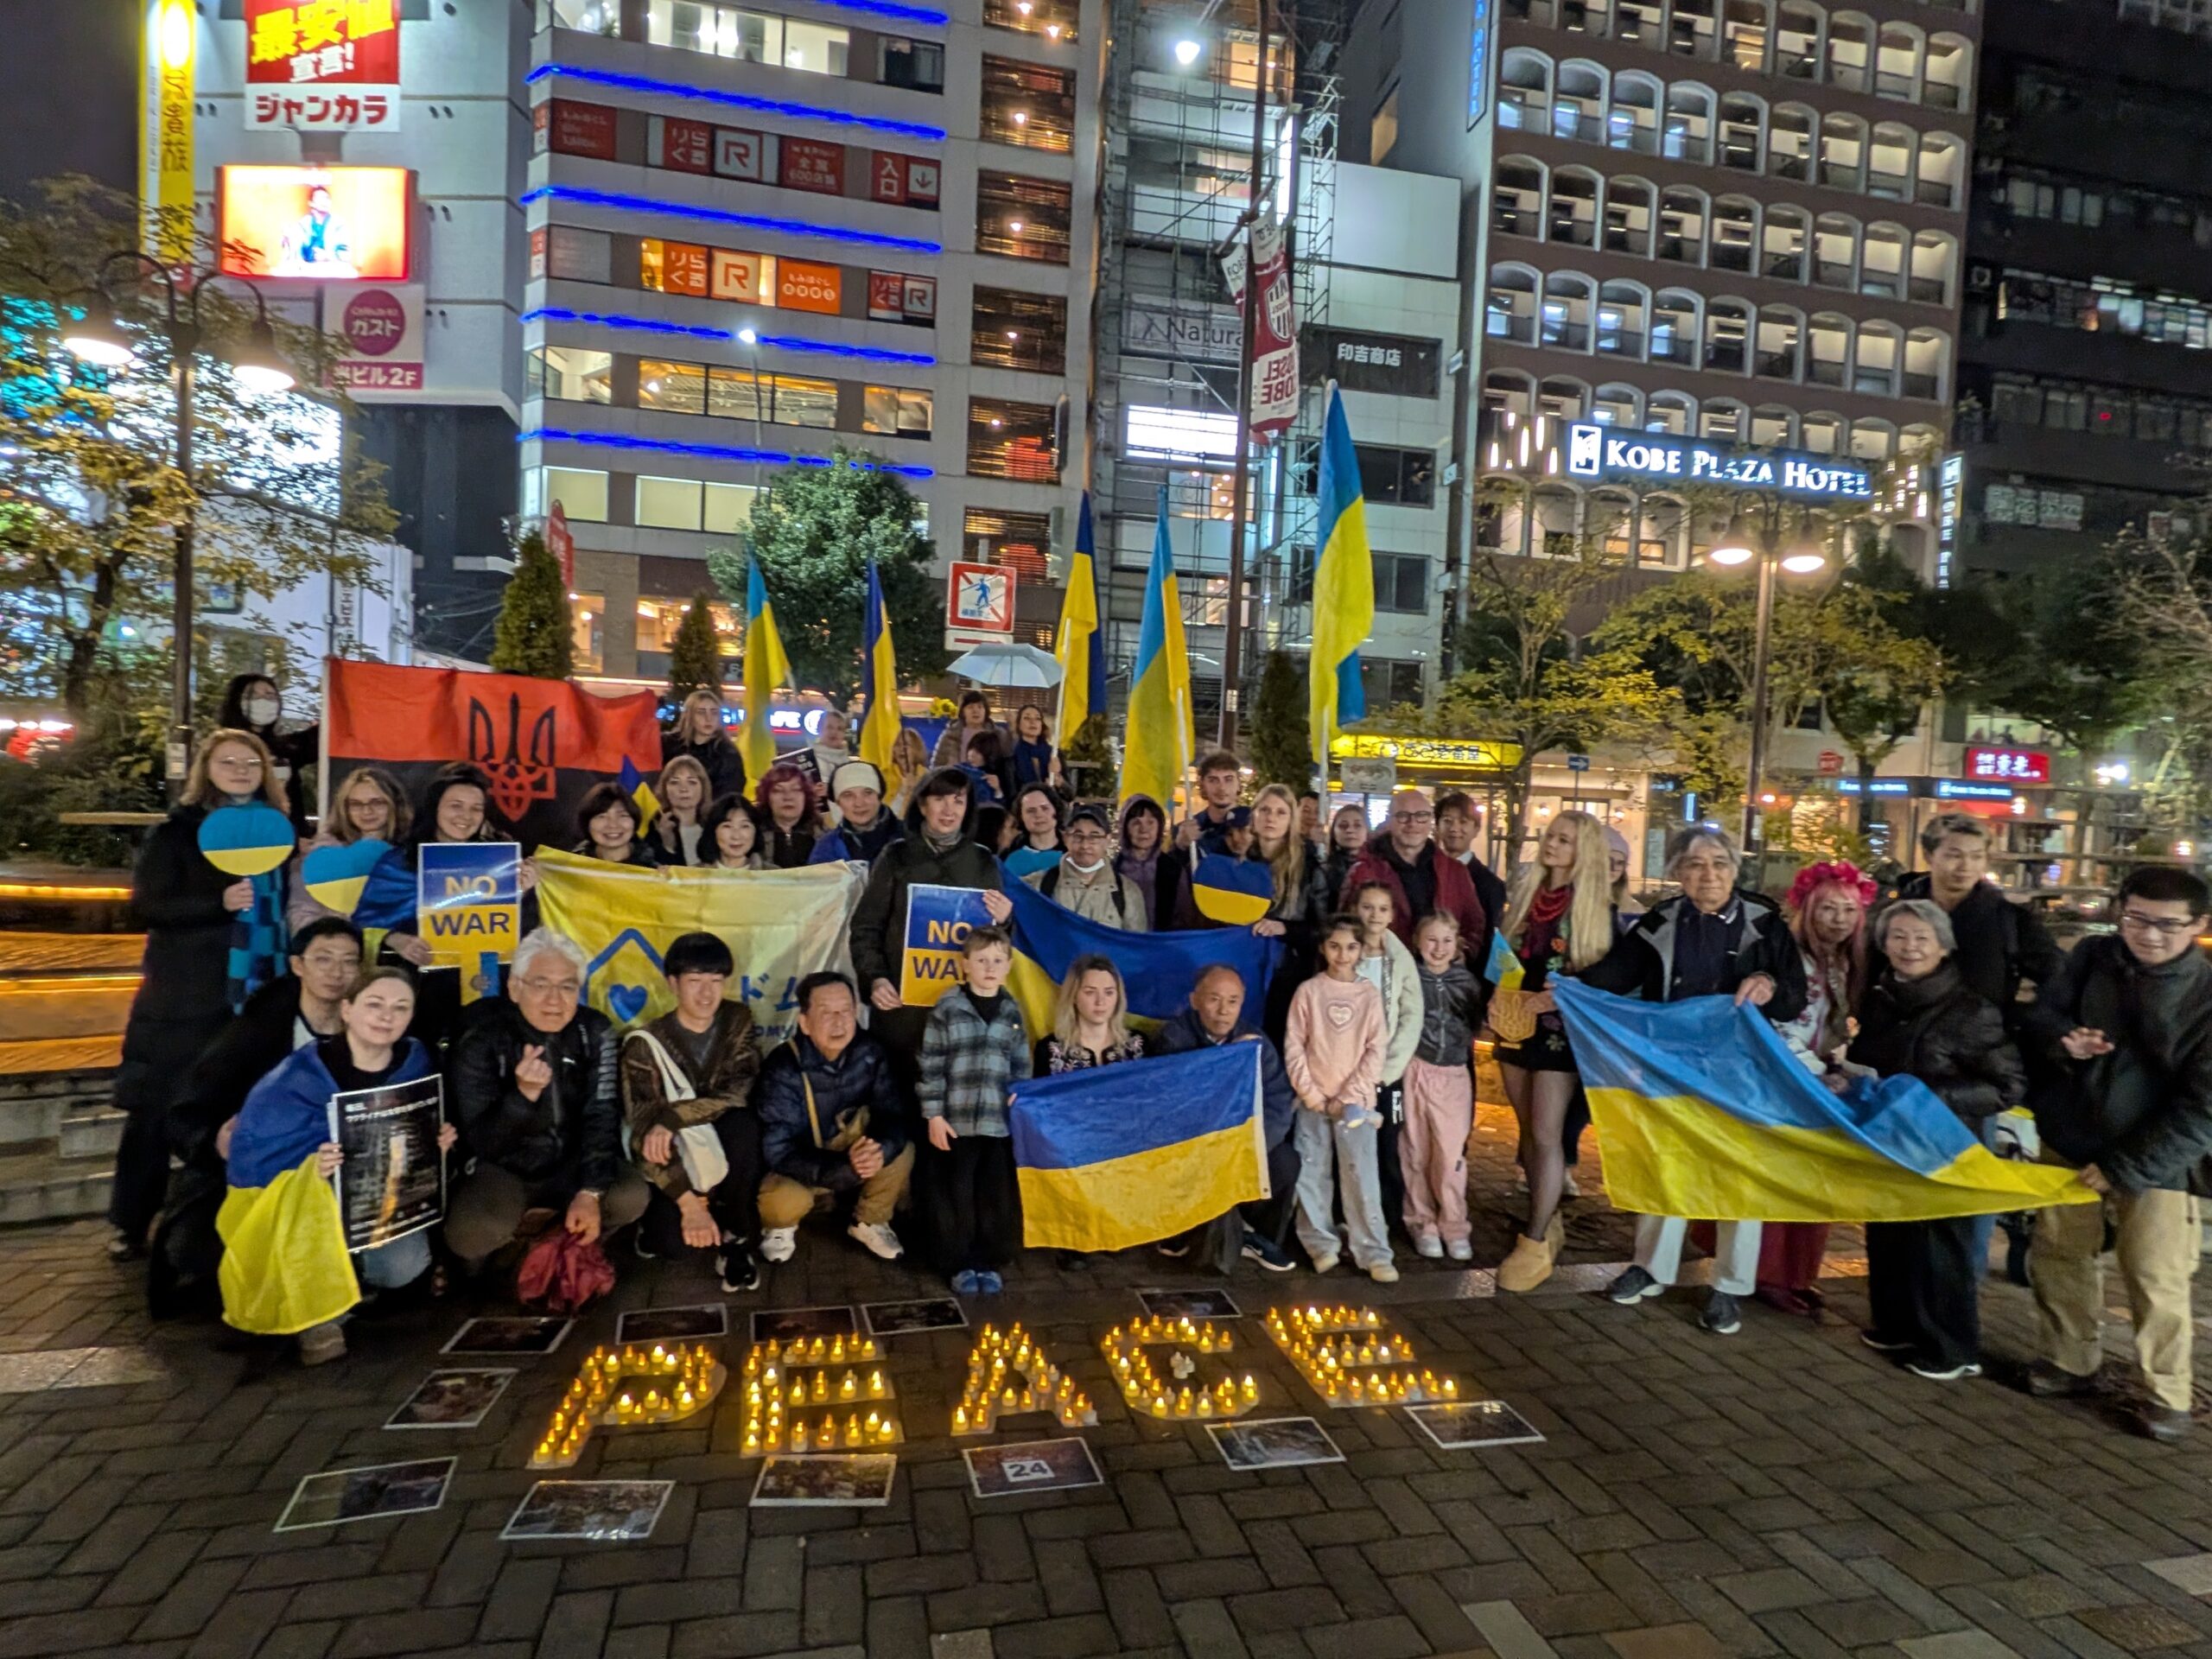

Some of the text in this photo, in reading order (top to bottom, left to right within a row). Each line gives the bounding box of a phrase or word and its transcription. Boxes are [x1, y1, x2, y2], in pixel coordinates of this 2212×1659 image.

[256, 92, 387, 124] ジャンカラ
[724, 142, 751, 168] R
[880, 157, 899, 196] 入口
[722, 263, 749, 289] R
[909, 288, 927, 306] R
[351, 318, 400, 337] ガスト
[444, 874, 497, 899] NO
[429, 912, 510, 937] WAR
[912, 956, 967, 981] WA
[525, 1305, 1460, 1469] PEACE
[1008, 1461, 1048, 1478] 24
